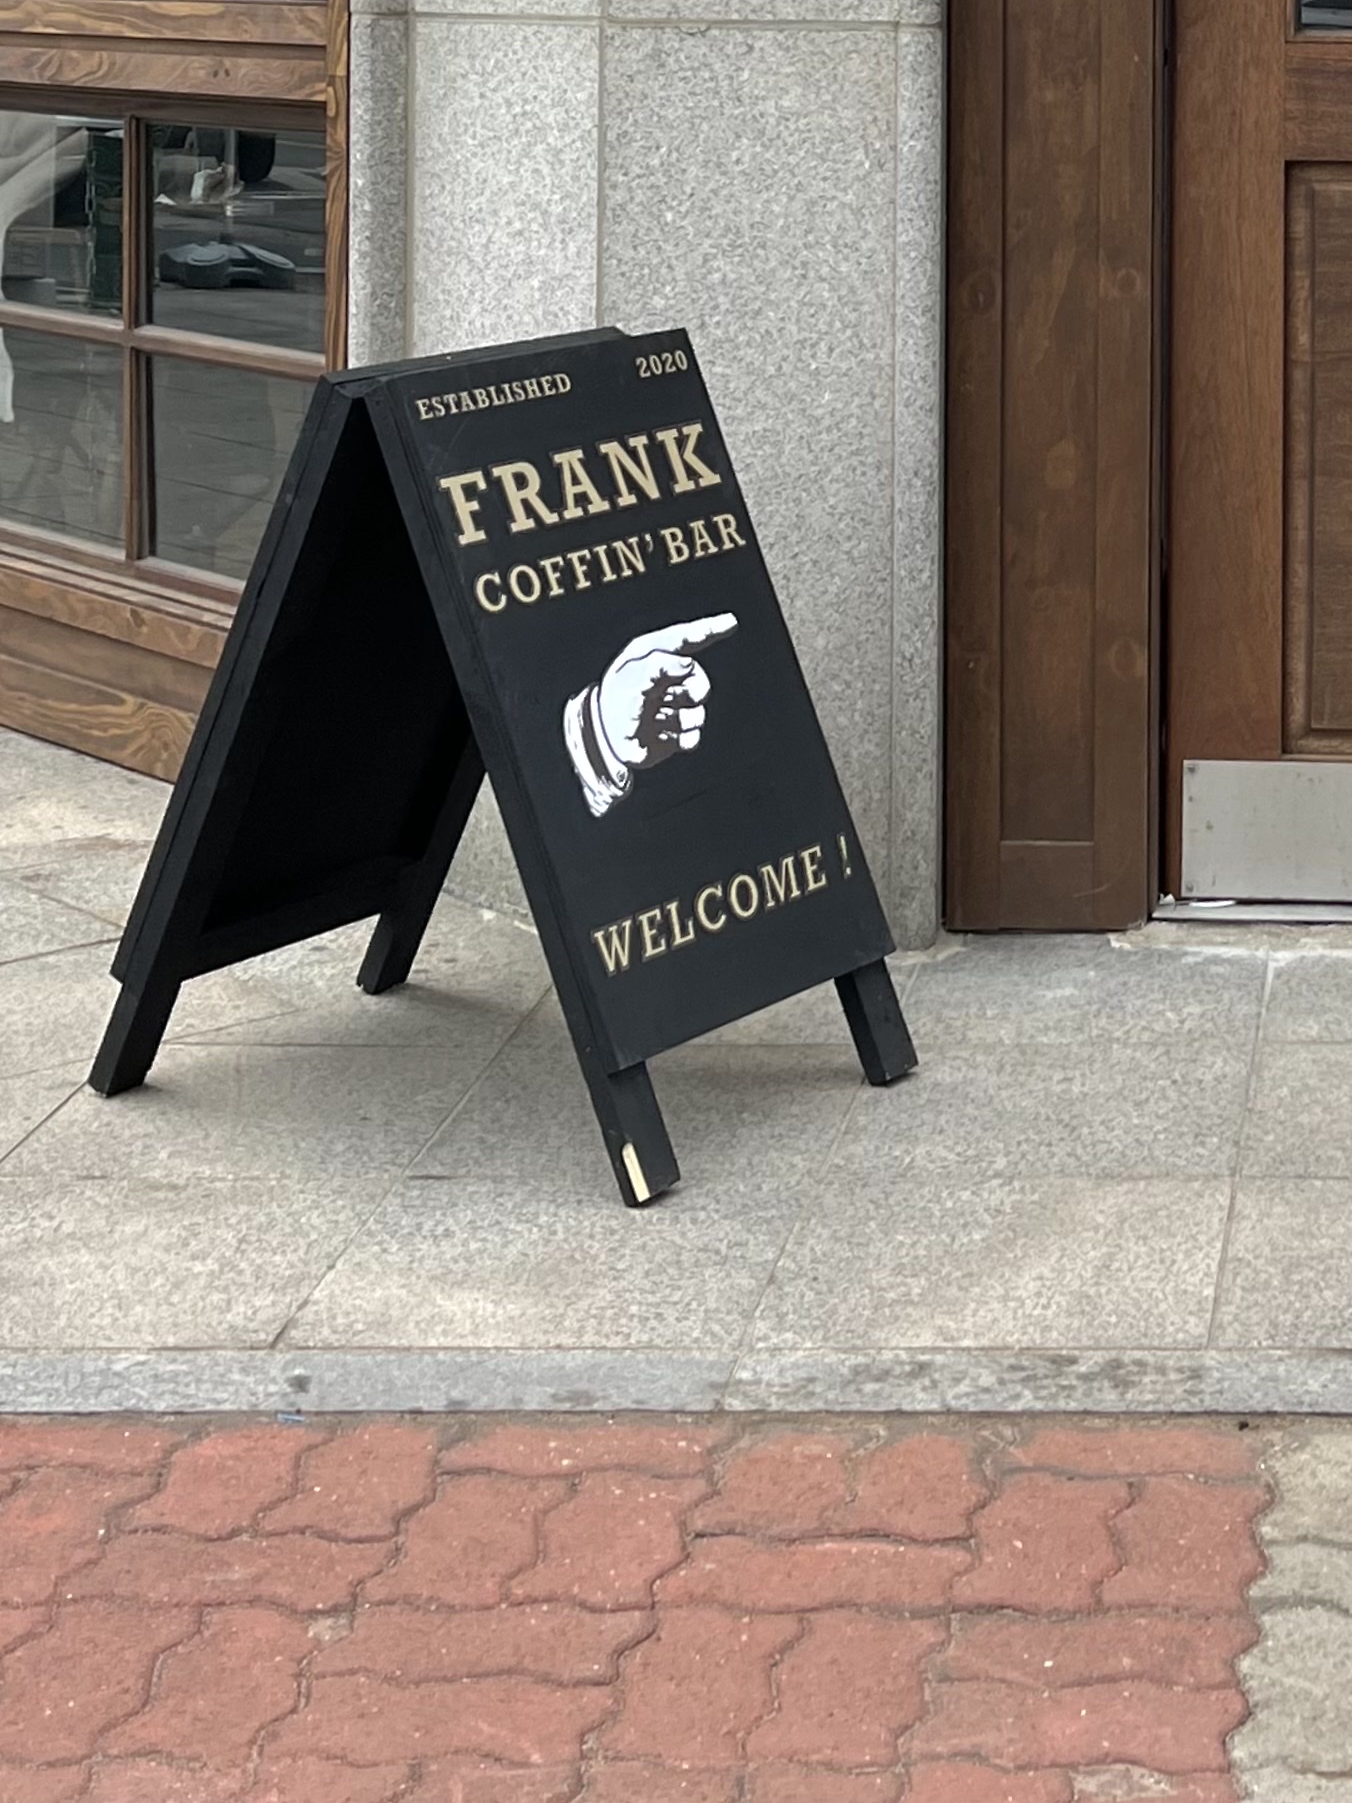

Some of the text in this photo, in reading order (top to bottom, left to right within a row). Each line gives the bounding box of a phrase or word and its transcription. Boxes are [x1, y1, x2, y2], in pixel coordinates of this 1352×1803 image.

[415, 349, 689, 421] ESTABLISHED 2020
[439, 421, 722, 547] FRANK
[474, 512, 746, 614] COFFIN' BAR
[592, 843, 827, 978] WELCOME
